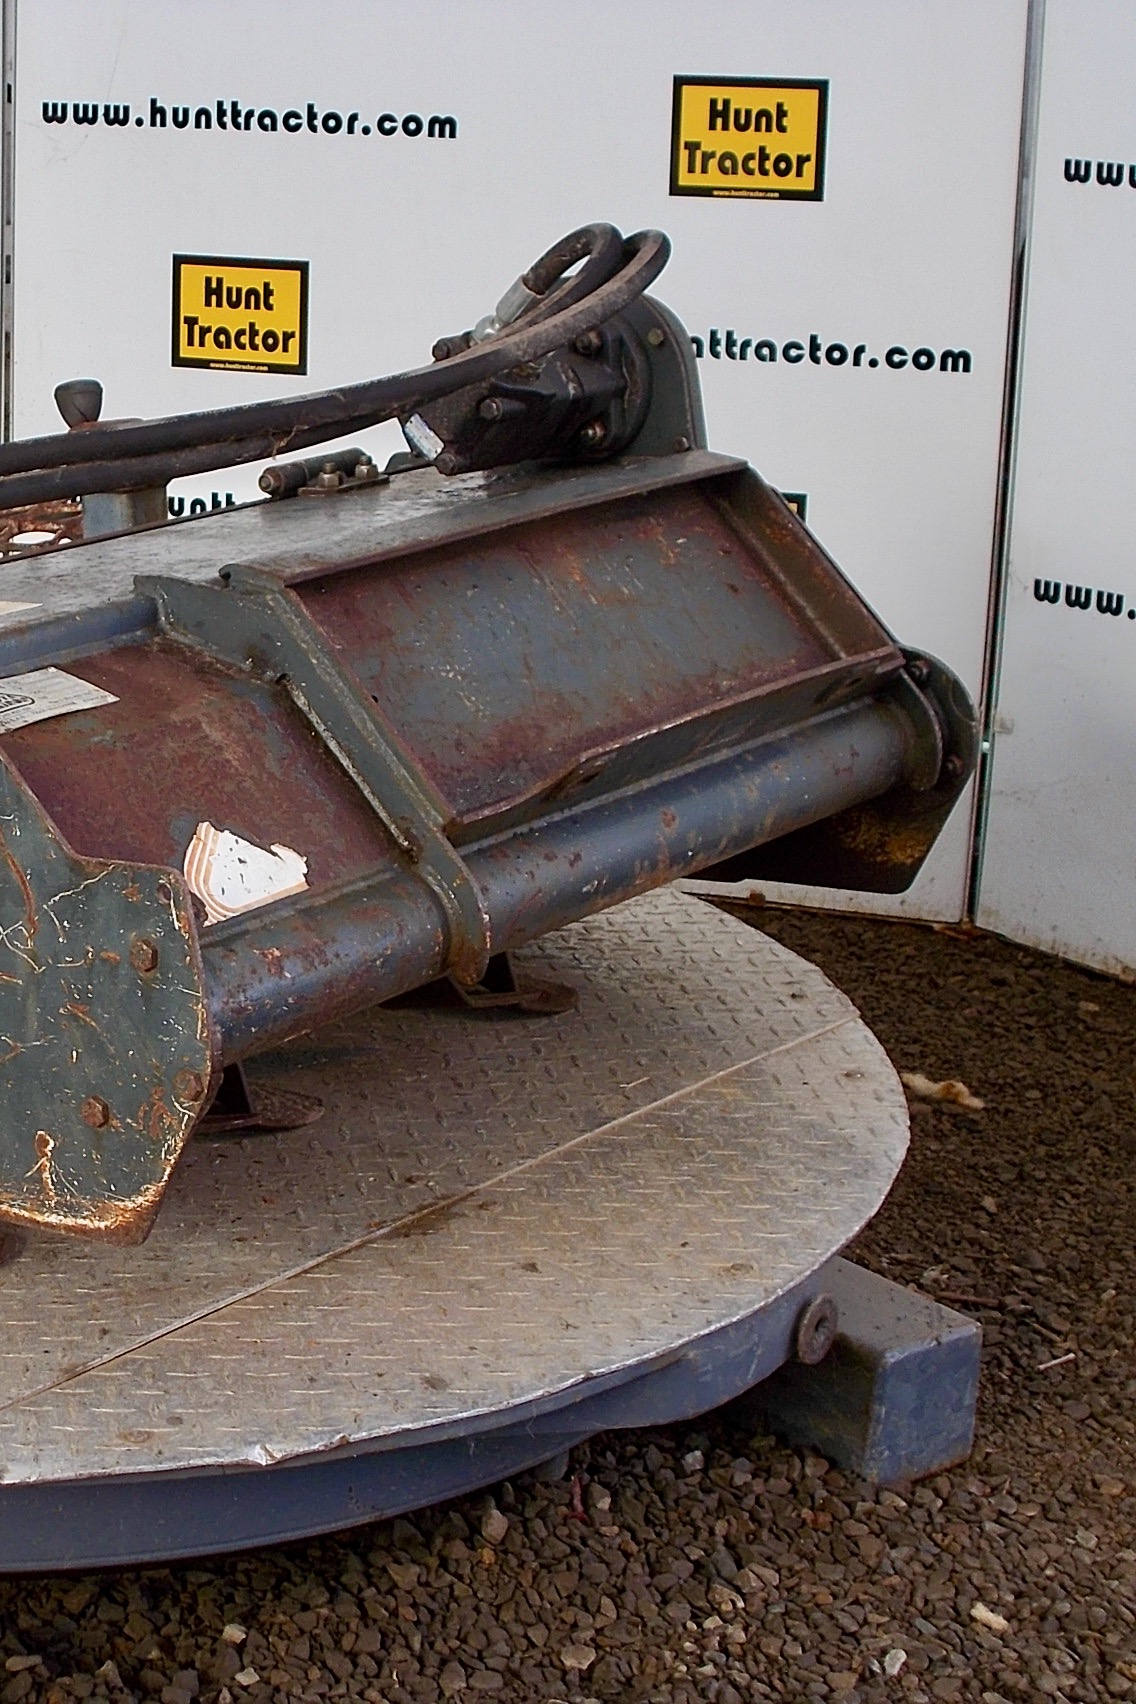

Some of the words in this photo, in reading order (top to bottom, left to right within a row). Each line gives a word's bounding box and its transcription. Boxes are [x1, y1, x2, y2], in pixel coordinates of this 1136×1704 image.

[43, 98, 456, 138] www.hunttractor.com
[709, 98, 787, 133] Hunt
[684, 141, 811, 177] Tractor
[1064, 159, 1136, 189] ww
[205, 276, 274, 311] Hunt
[184, 316, 295, 353] Tractor
[1034, 578, 1136, 620] www.
